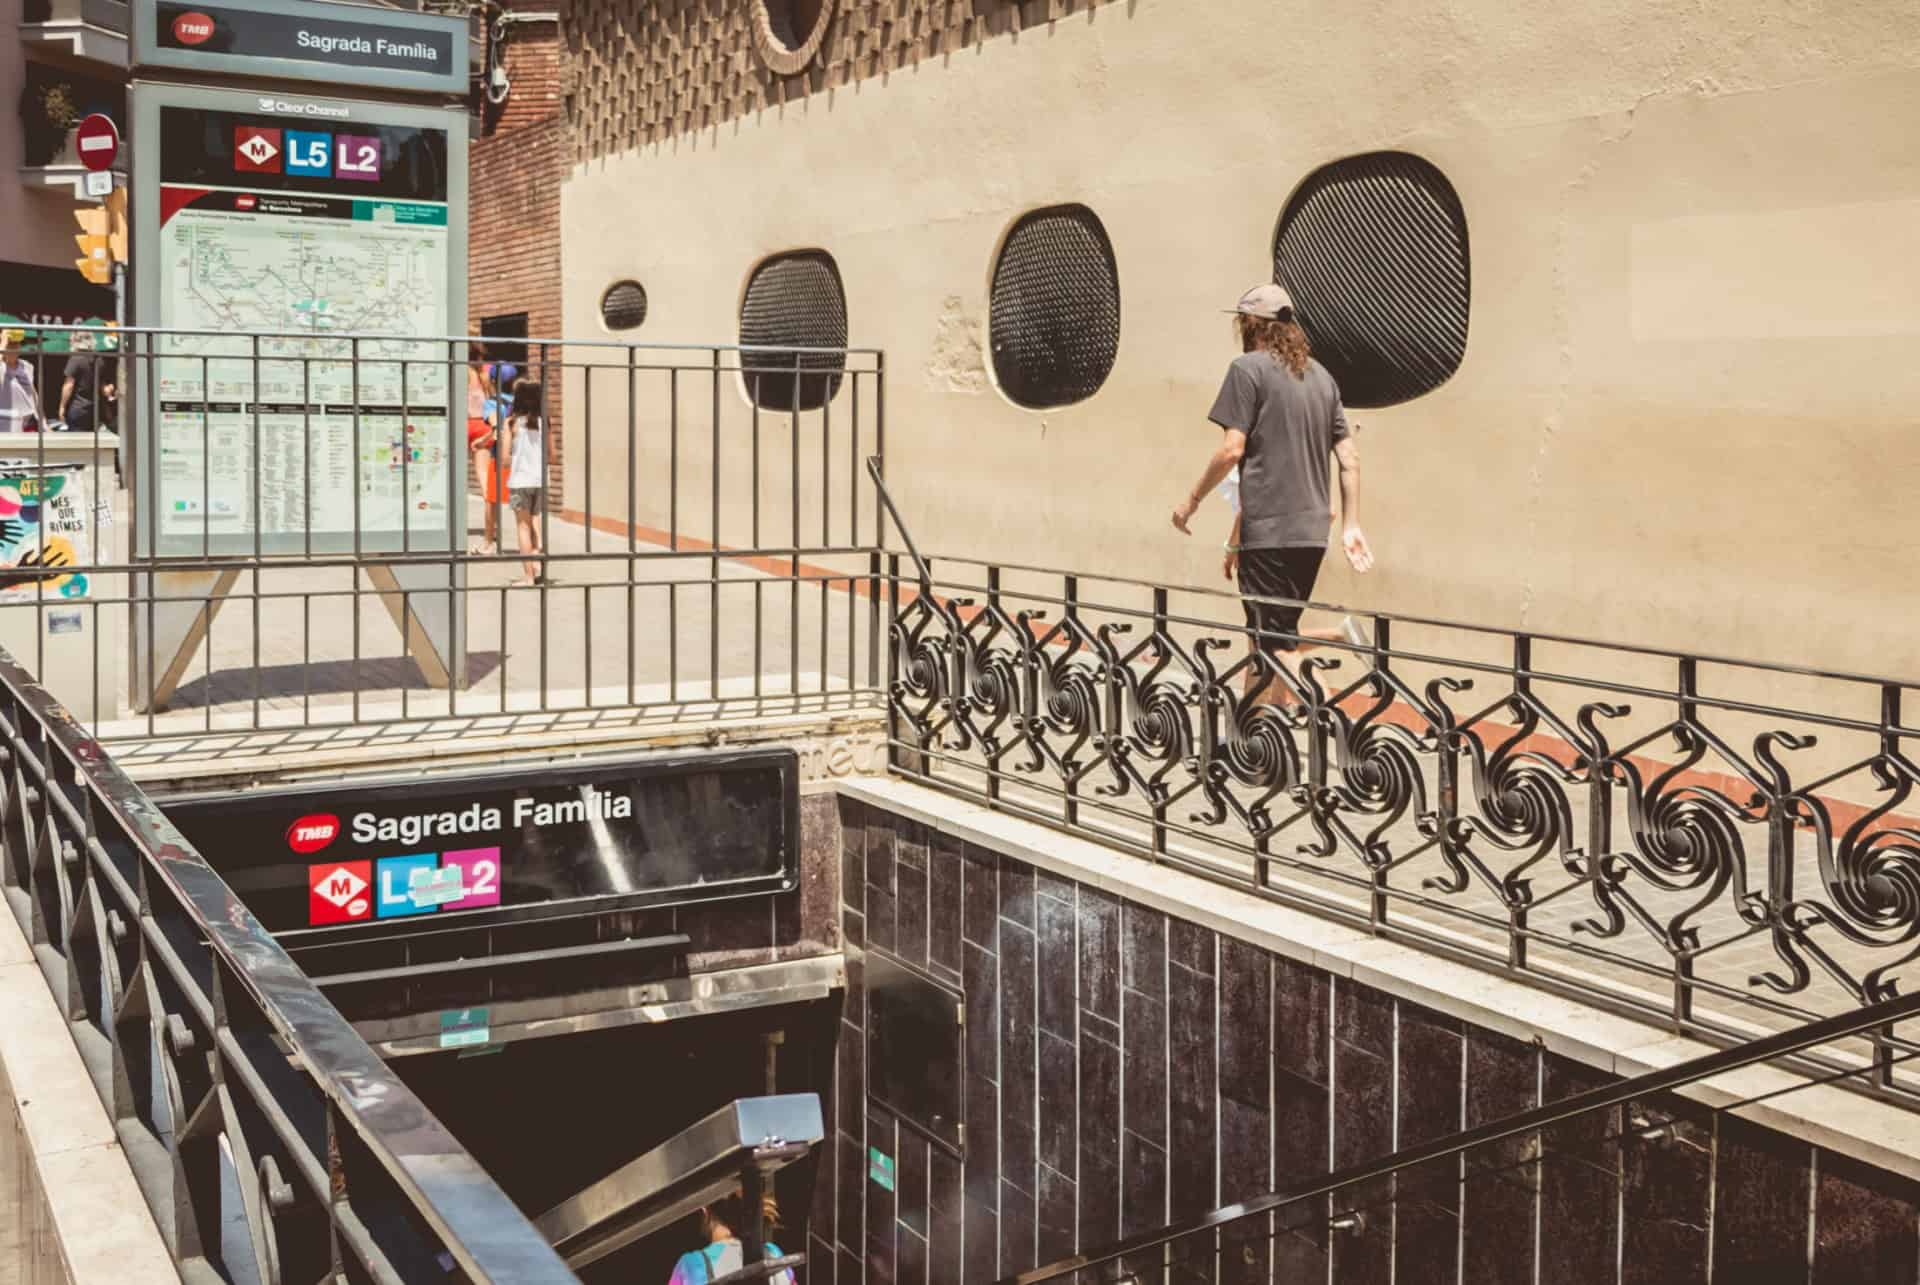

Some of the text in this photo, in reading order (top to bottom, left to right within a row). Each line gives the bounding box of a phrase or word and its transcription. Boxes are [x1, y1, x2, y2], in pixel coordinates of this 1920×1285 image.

[180, 23, 209, 35] TMB
[297, 30, 438, 60] Sagrada Família
[305, 104, 350, 117] Channel
[250, 143, 266, 157] M
[288, 138, 378, 172] L5 L2
[296, 824, 334, 842] TMB
[352, 803, 501, 845] Sagrada
[330, 879, 352, 897] M
